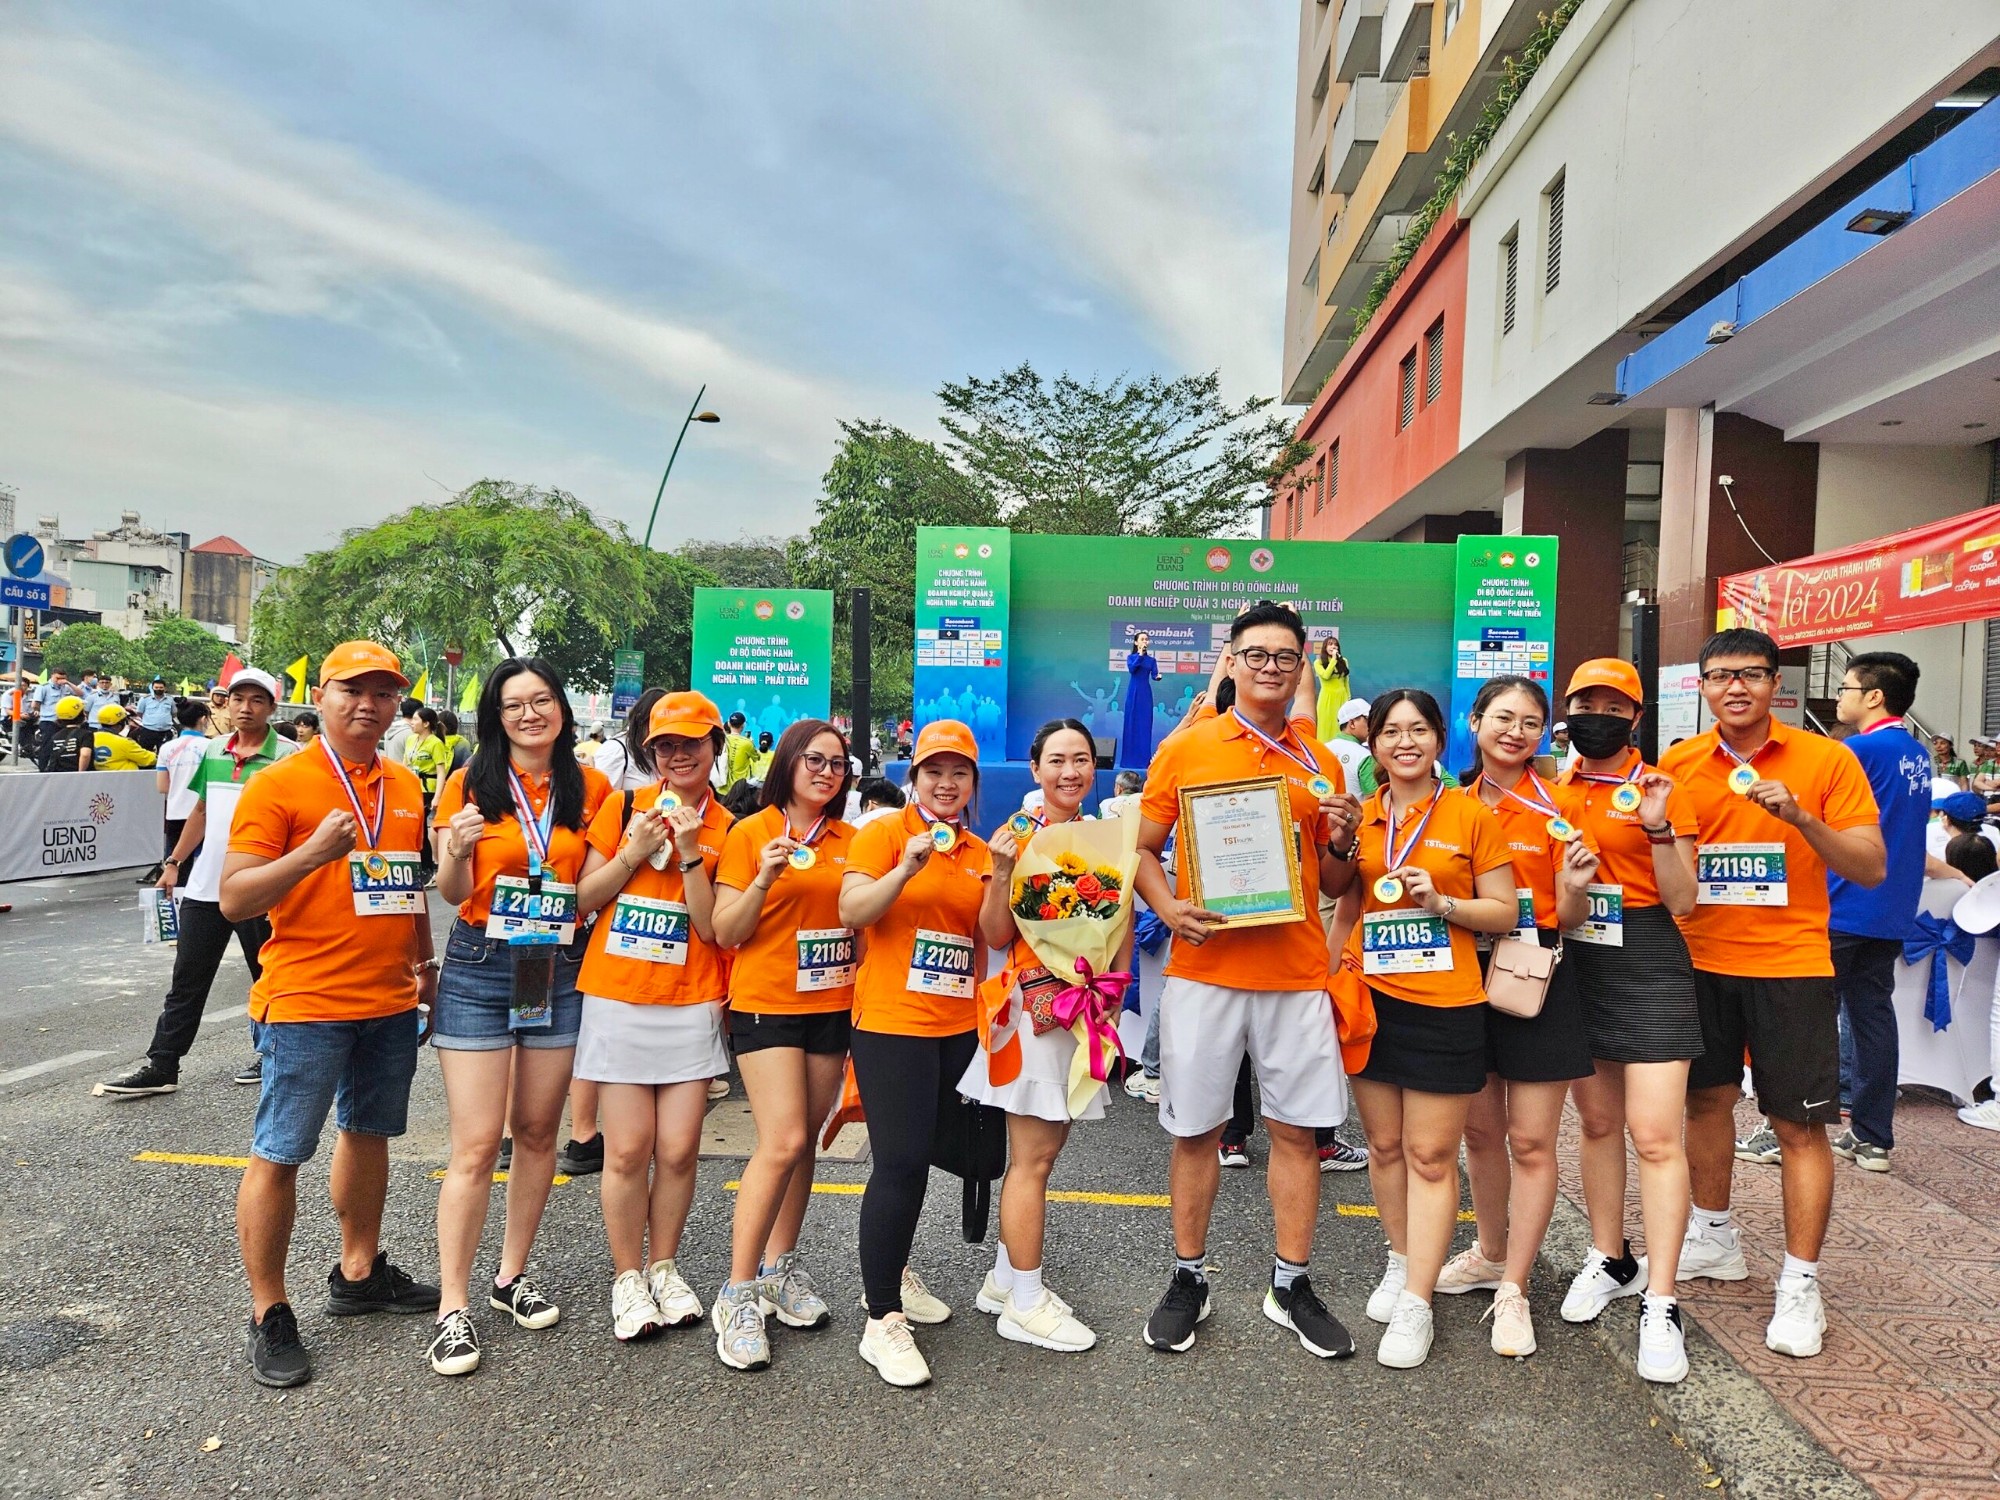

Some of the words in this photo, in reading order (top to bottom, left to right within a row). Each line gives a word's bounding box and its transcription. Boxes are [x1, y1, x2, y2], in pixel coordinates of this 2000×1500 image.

[1823, 565, 1839, 581] QUÀ
[1840, 561, 1863, 577] THÀNH
[1864, 555, 1884, 570] VIÊN
[4, 585, 23, 599] CẦU
[26, 588, 40, 601] SỐ
[40, 593, 47, 601] 8
[1153, 579, 1190, 591] CHƯƠNG
[1191, 578, 1218, 591] TRÌNH
[1232, 580, 1245, 594] BỘ
[1247, 580, 1271, 593] ĐỒNG
[1273, 580, 1299, 594] HÀNH
[1108, 595, 1142, 607] DOANH
[1144, 594, 1180, 610] NGHIỆP
[1182, 594, 1209, 610] QUẬN
[1212, 598, 1219, 608] 3
[1315, 597, 1344, 612] TRIỂN
[1776, 568, 1813, 630] Tết
[1814, 576, 1880, 624] 2024
[767, 634, 788, 647] TRÌNH
[1314, 630, 1333, 638] ACB
[740, 647, 750, 659] BỘ
[773, 647, 794, 658] HÀNH
[715, 661, 743, 671] DOANH
[745, 659, 776, 674] NGHIỆP
[777, 659, 800, 675] QUẬN
[801, 662, 808, 673] 3
[712, 672, 738, 685] NGHĨA
[739, 671, 757, 685] TÌNH
[765, 673, 786, 686] PHÁT
[787, 672, 810, 686] TRIỂN
[43, 825, 97, 847] UBND
[1711, 856, 1768, 878] 21196
[508, 891, 566, 917] 2188
[626, 909, 678, 936] 21187
[1377, 922, 1433, 946] 21185
[812, 941, 852, 964] 21186
[925, 945, 969, 971] 21200
